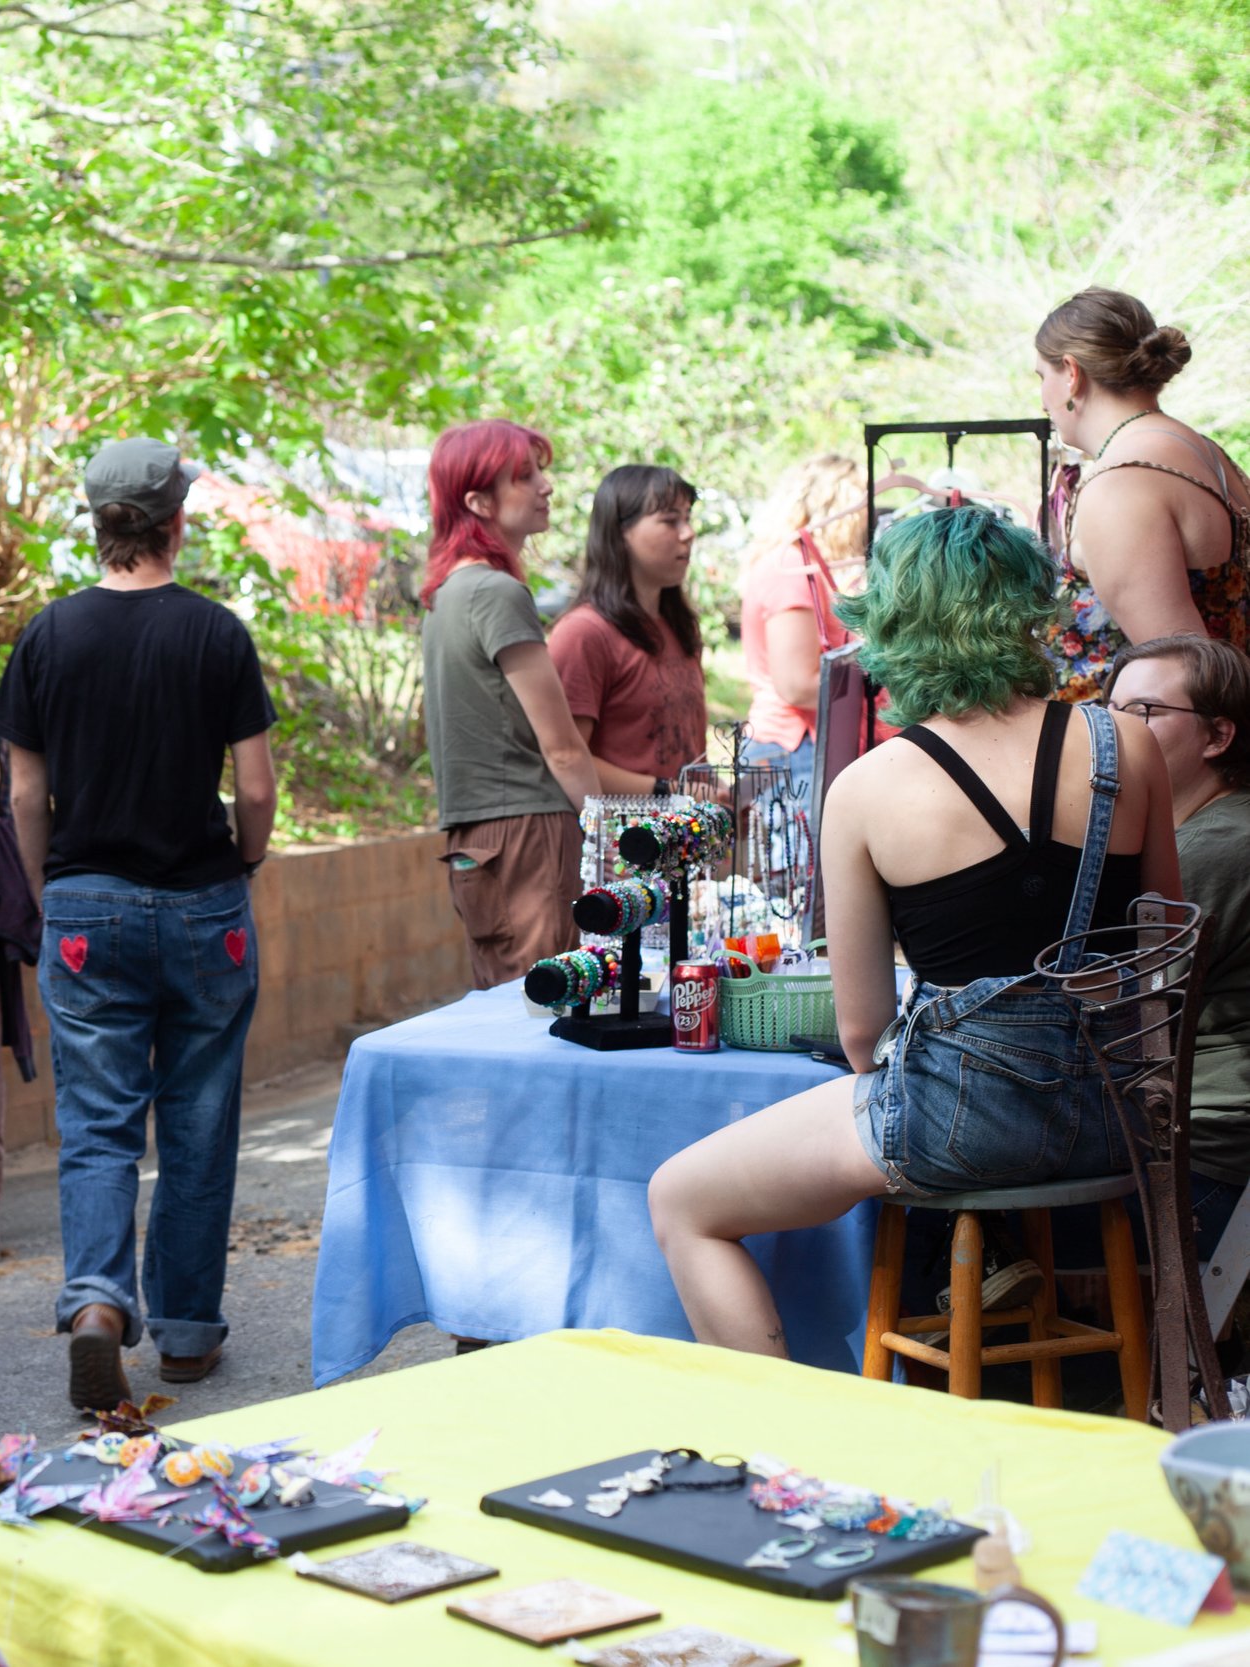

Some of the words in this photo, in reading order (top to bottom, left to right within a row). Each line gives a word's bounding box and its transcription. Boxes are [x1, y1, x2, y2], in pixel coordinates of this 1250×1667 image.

[688, 980, 704, 995] Dr
[673, 983, 715, 1011] Pepper
[680, 1015, 691, 1027] 23
